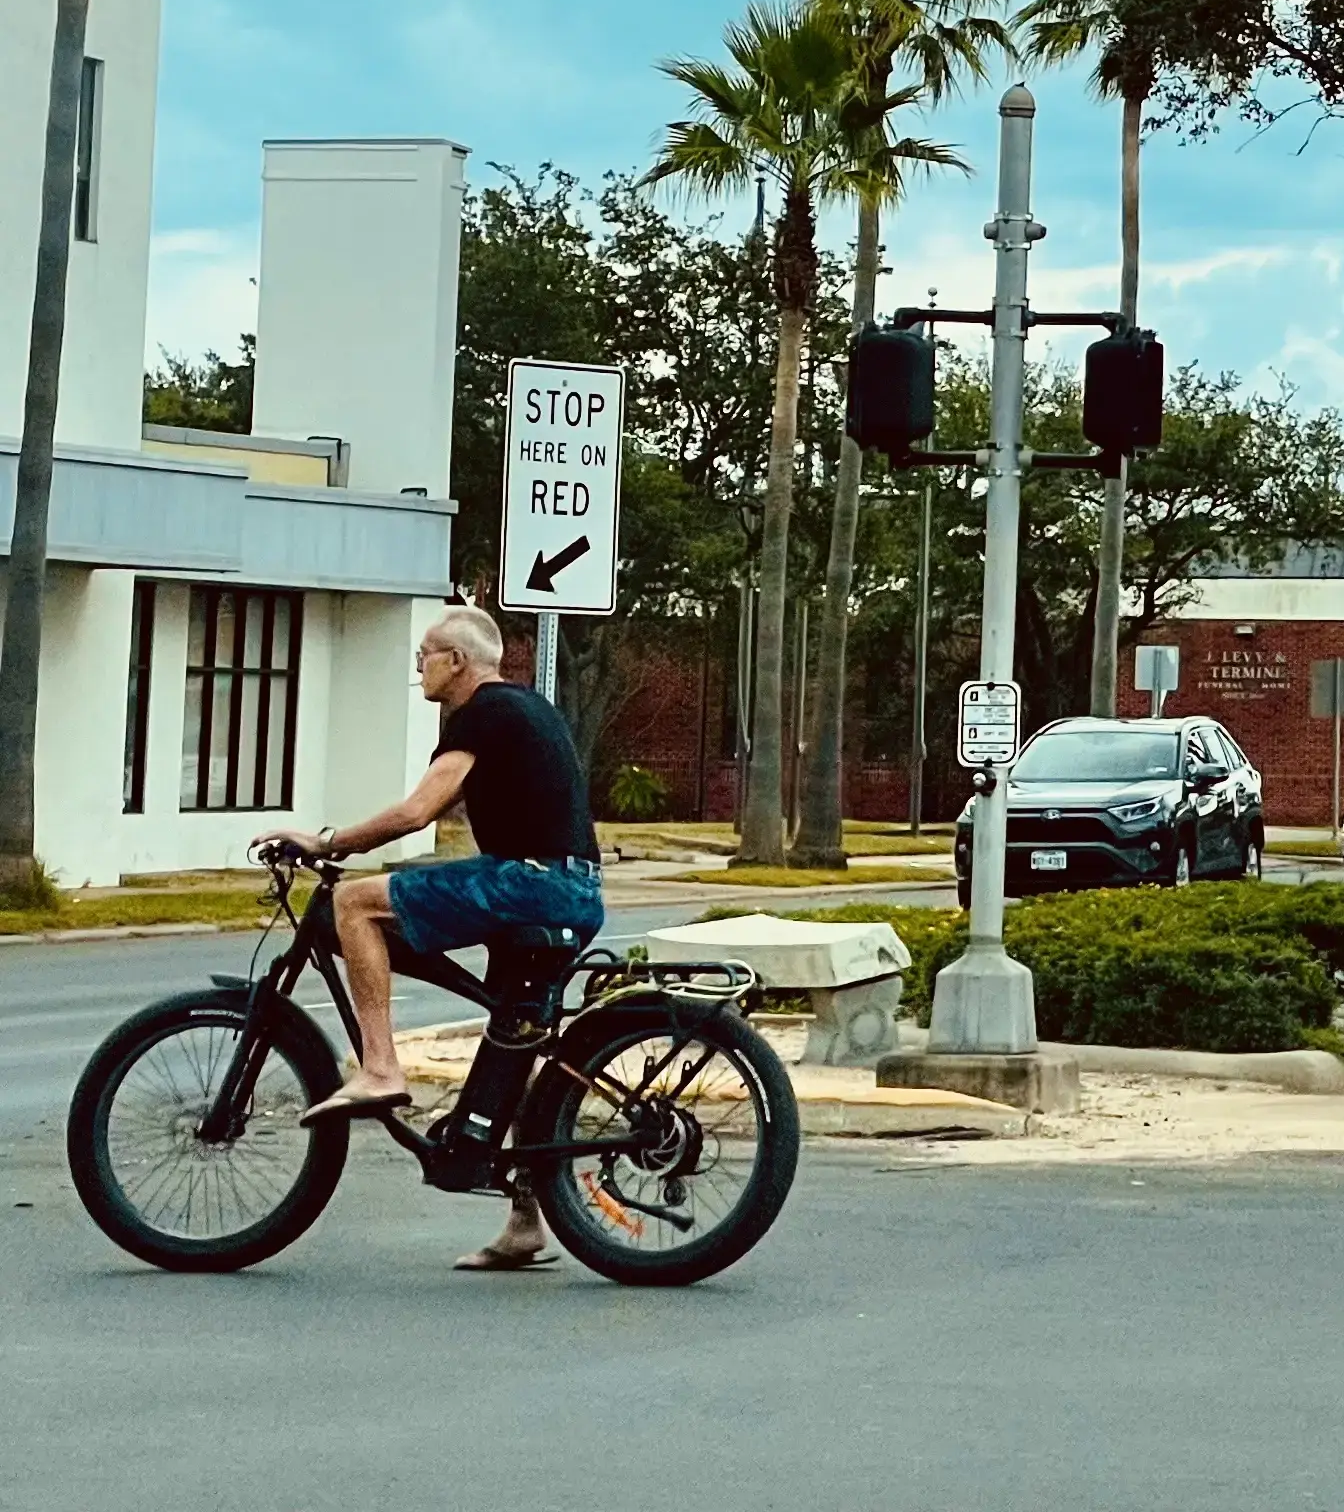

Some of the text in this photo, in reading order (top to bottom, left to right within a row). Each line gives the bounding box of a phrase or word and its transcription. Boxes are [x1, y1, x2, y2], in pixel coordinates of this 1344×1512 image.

[525, 388, 605, 427] STOP
[520, 440, 606, 466] HERE ON
[531, 479, 590, 516] RED
